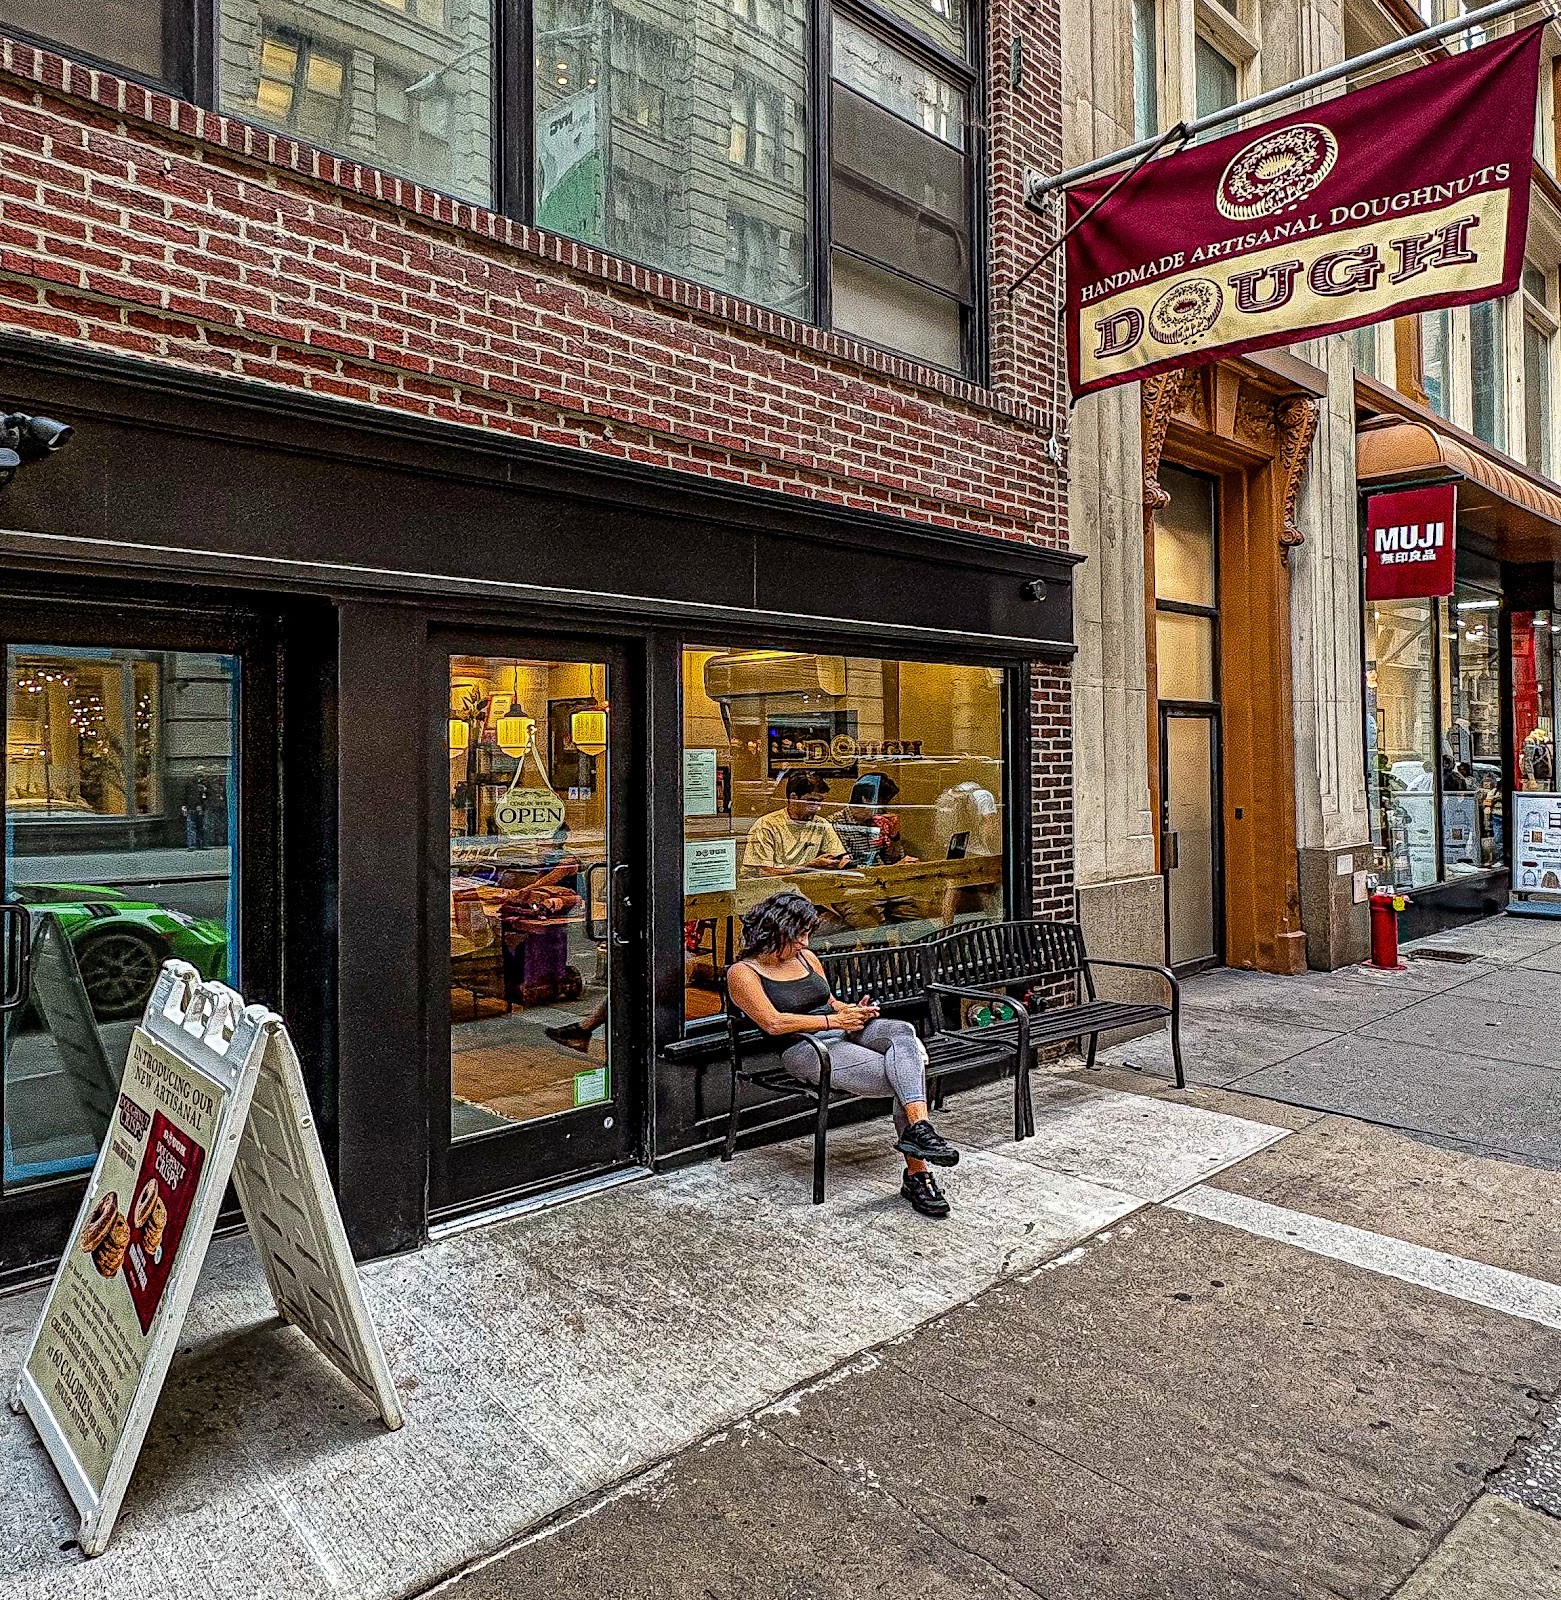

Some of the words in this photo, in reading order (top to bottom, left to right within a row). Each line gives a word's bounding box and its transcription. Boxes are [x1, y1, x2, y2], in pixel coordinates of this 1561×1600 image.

[1080, 251, 1185, 302] HANDMADE
[1190, 214, 1322, 264] ARTISANAL
[1329, 163, 1511, 226] DOUGHNUTS
[1374, 522, 1445, 552] MUJI
[1380, 549, 1437, 565] 無印良品
[499, 807, 562, 824] OPEN
[134, 1044, 191, 1098] INTRODUCING
[192, 1089, 213, 1117] OUR
[134, 1066, 154, 1088] NEW
[153, 1081, 202, 1131] ARTISANAL
[155, 1156, 179, 1191] CRISPS
[52, 1348, 63, 1369] 60
[60, 1359, 93, 1418] CALORIES
